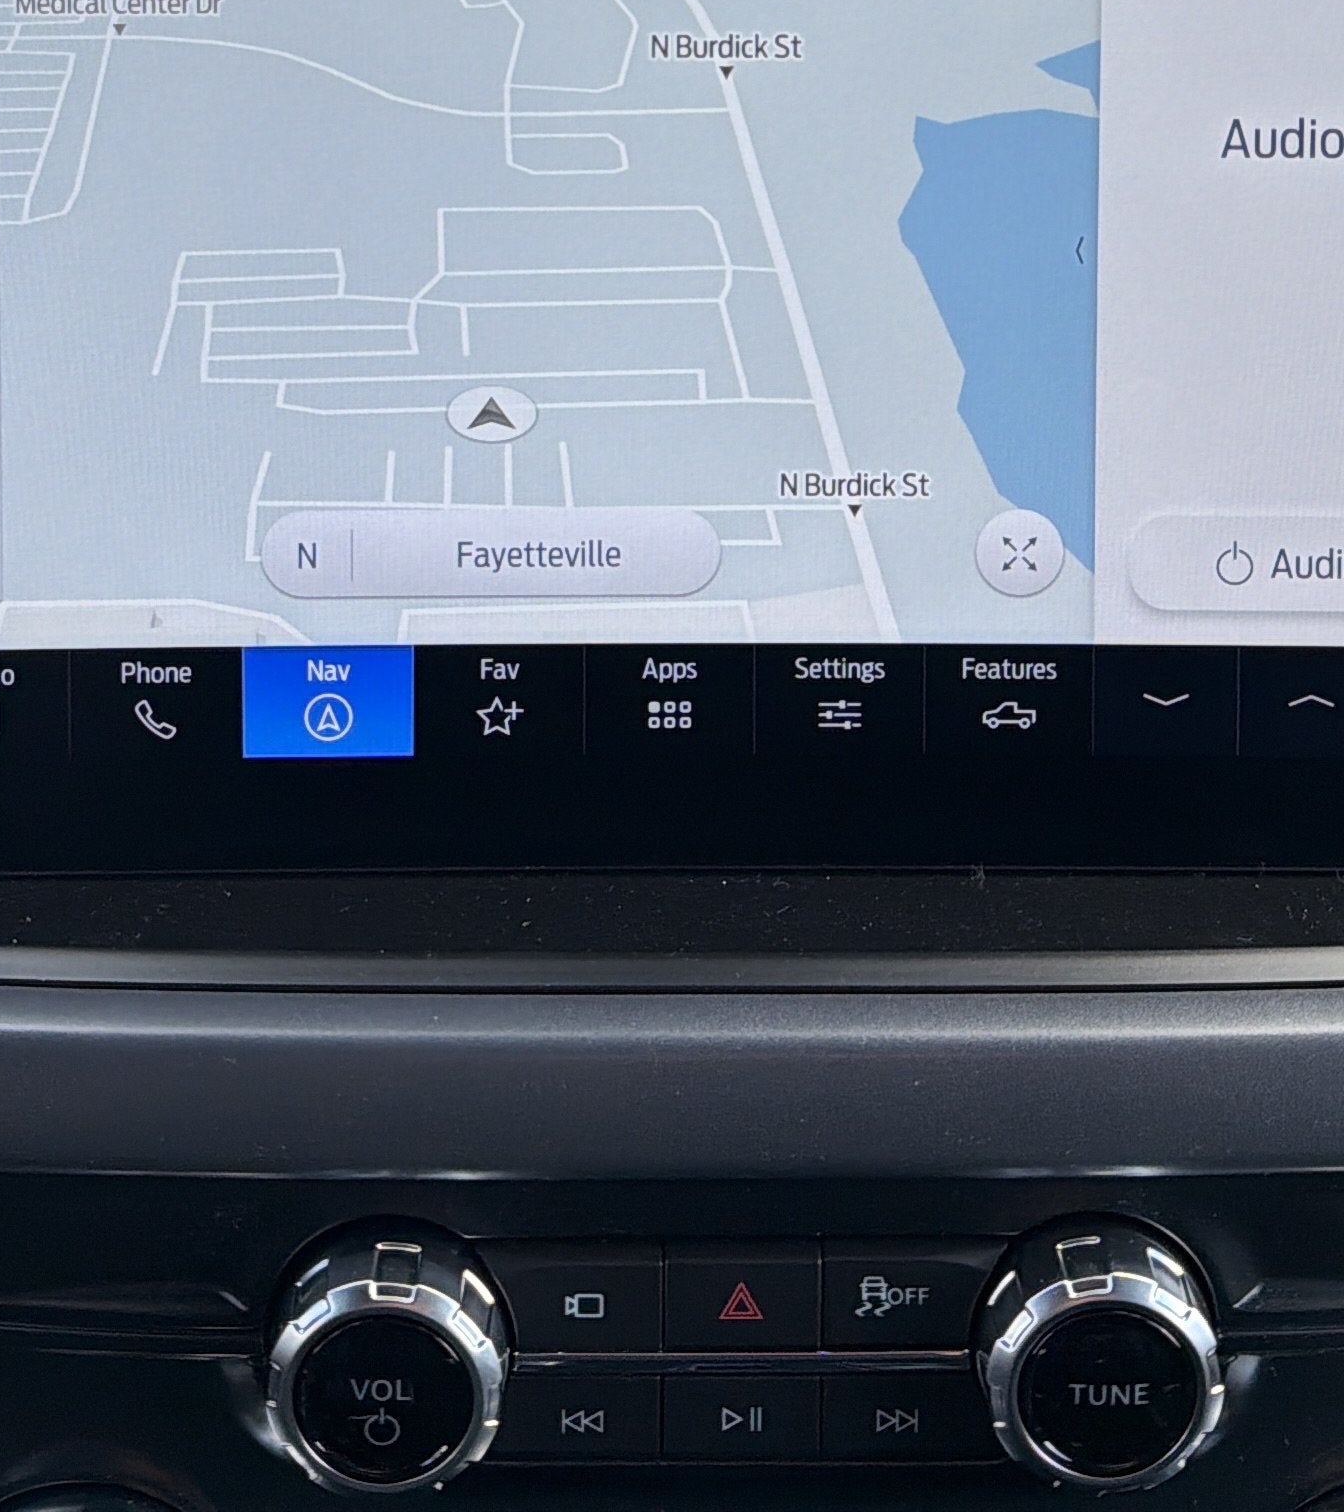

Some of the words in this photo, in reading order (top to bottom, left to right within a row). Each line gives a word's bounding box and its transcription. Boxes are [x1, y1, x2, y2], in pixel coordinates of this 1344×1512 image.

[651, 36, 670, 59] N
[676, 34, 769, 60] Burdick
[774, 36, 803, 59] St
[780, 474, 798, 497] N
[804, 472, 895, 498] Burdick
[901, 473, 930, 497] St
[297, 543, 317, 569] N
[456, 540, 622, 574] Fayetteville
[120, 661, 193, 685] Phone
[306, 659, 352, 682] Nav
[479, 658, 520, 681] Fav
[641, 658, 698, 687] Apps
[794, 657, 886, 687] Settings
[961, 657, 1058, 681] Features
[887, 1287, 930, 1305] OFF
[350, 1378, 413, 1402] VOL
[1068, 1382, 1151, 1406] TUNE
